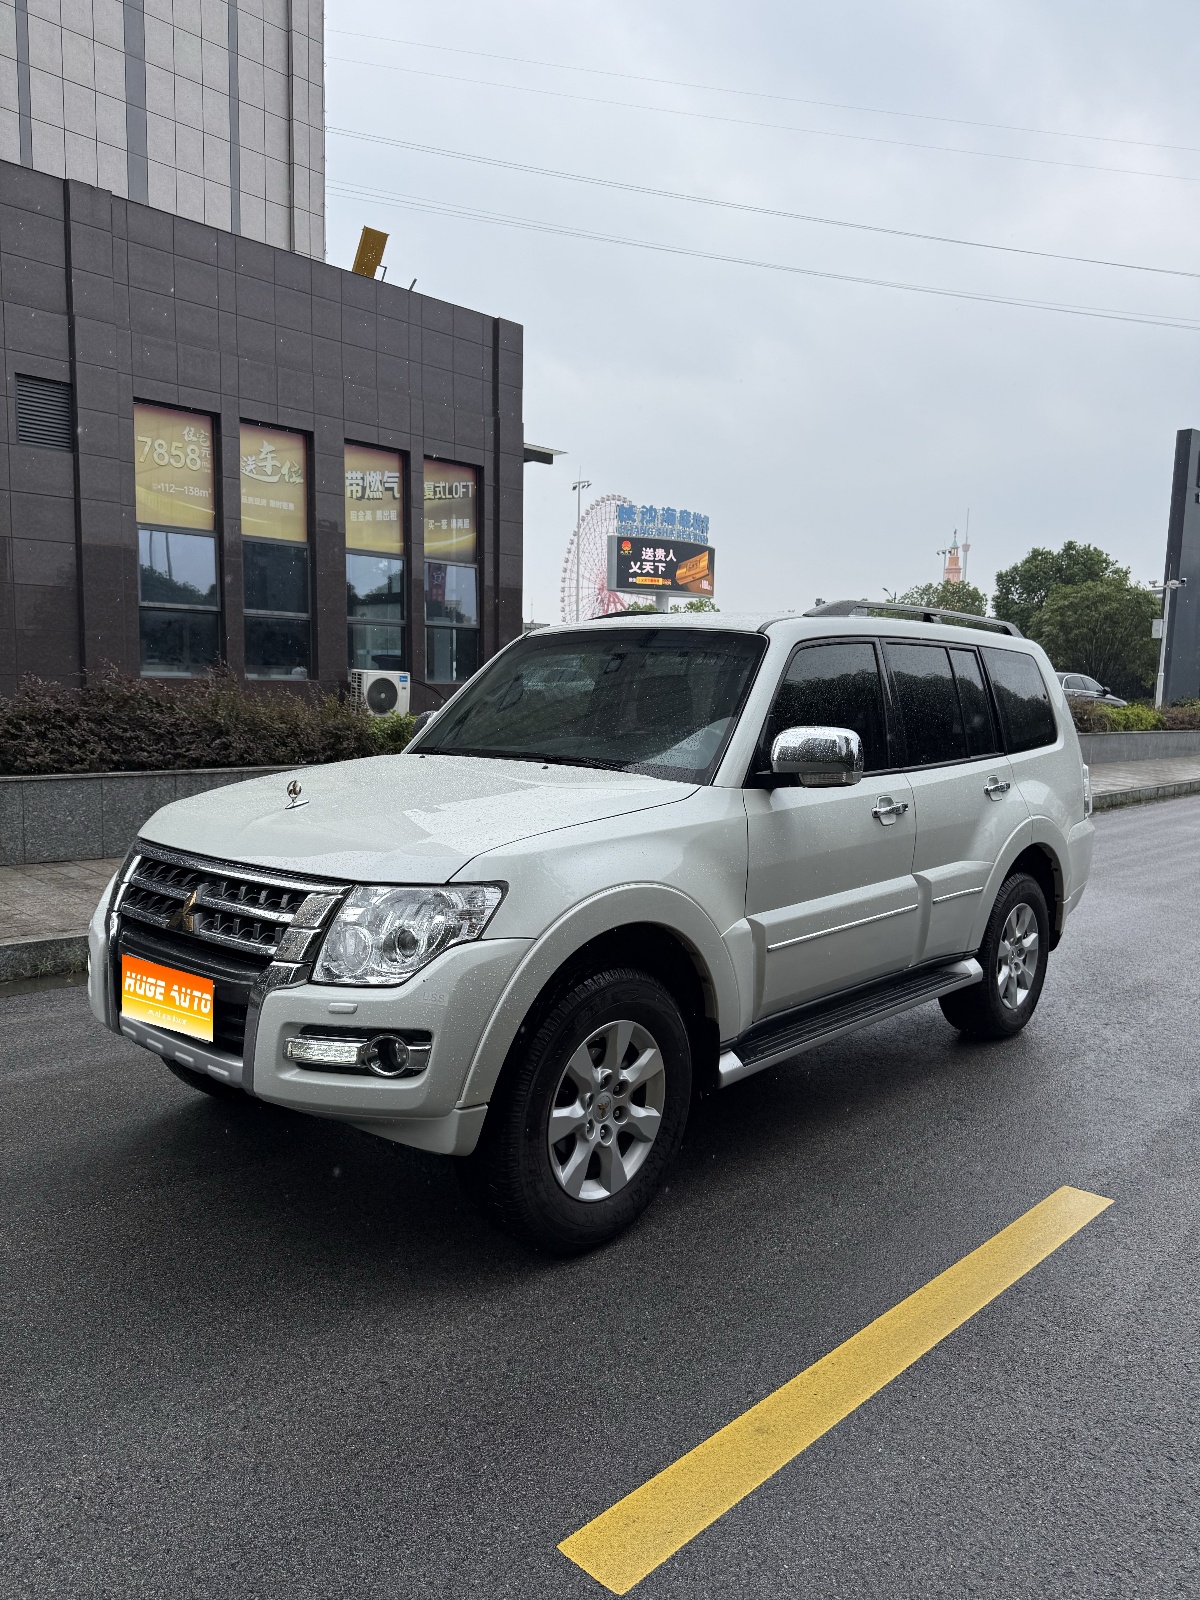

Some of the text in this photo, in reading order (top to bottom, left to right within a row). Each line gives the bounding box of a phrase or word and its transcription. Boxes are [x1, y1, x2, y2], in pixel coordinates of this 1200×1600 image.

[137, 435, 201, 471] 7858
[240, 440, 304, 485] 送车位
[345, 470, 400, 499] 带燃气
[424, 481, 474, 499] 复式LOFT
[641, 547, 677, 562] 送贵人
